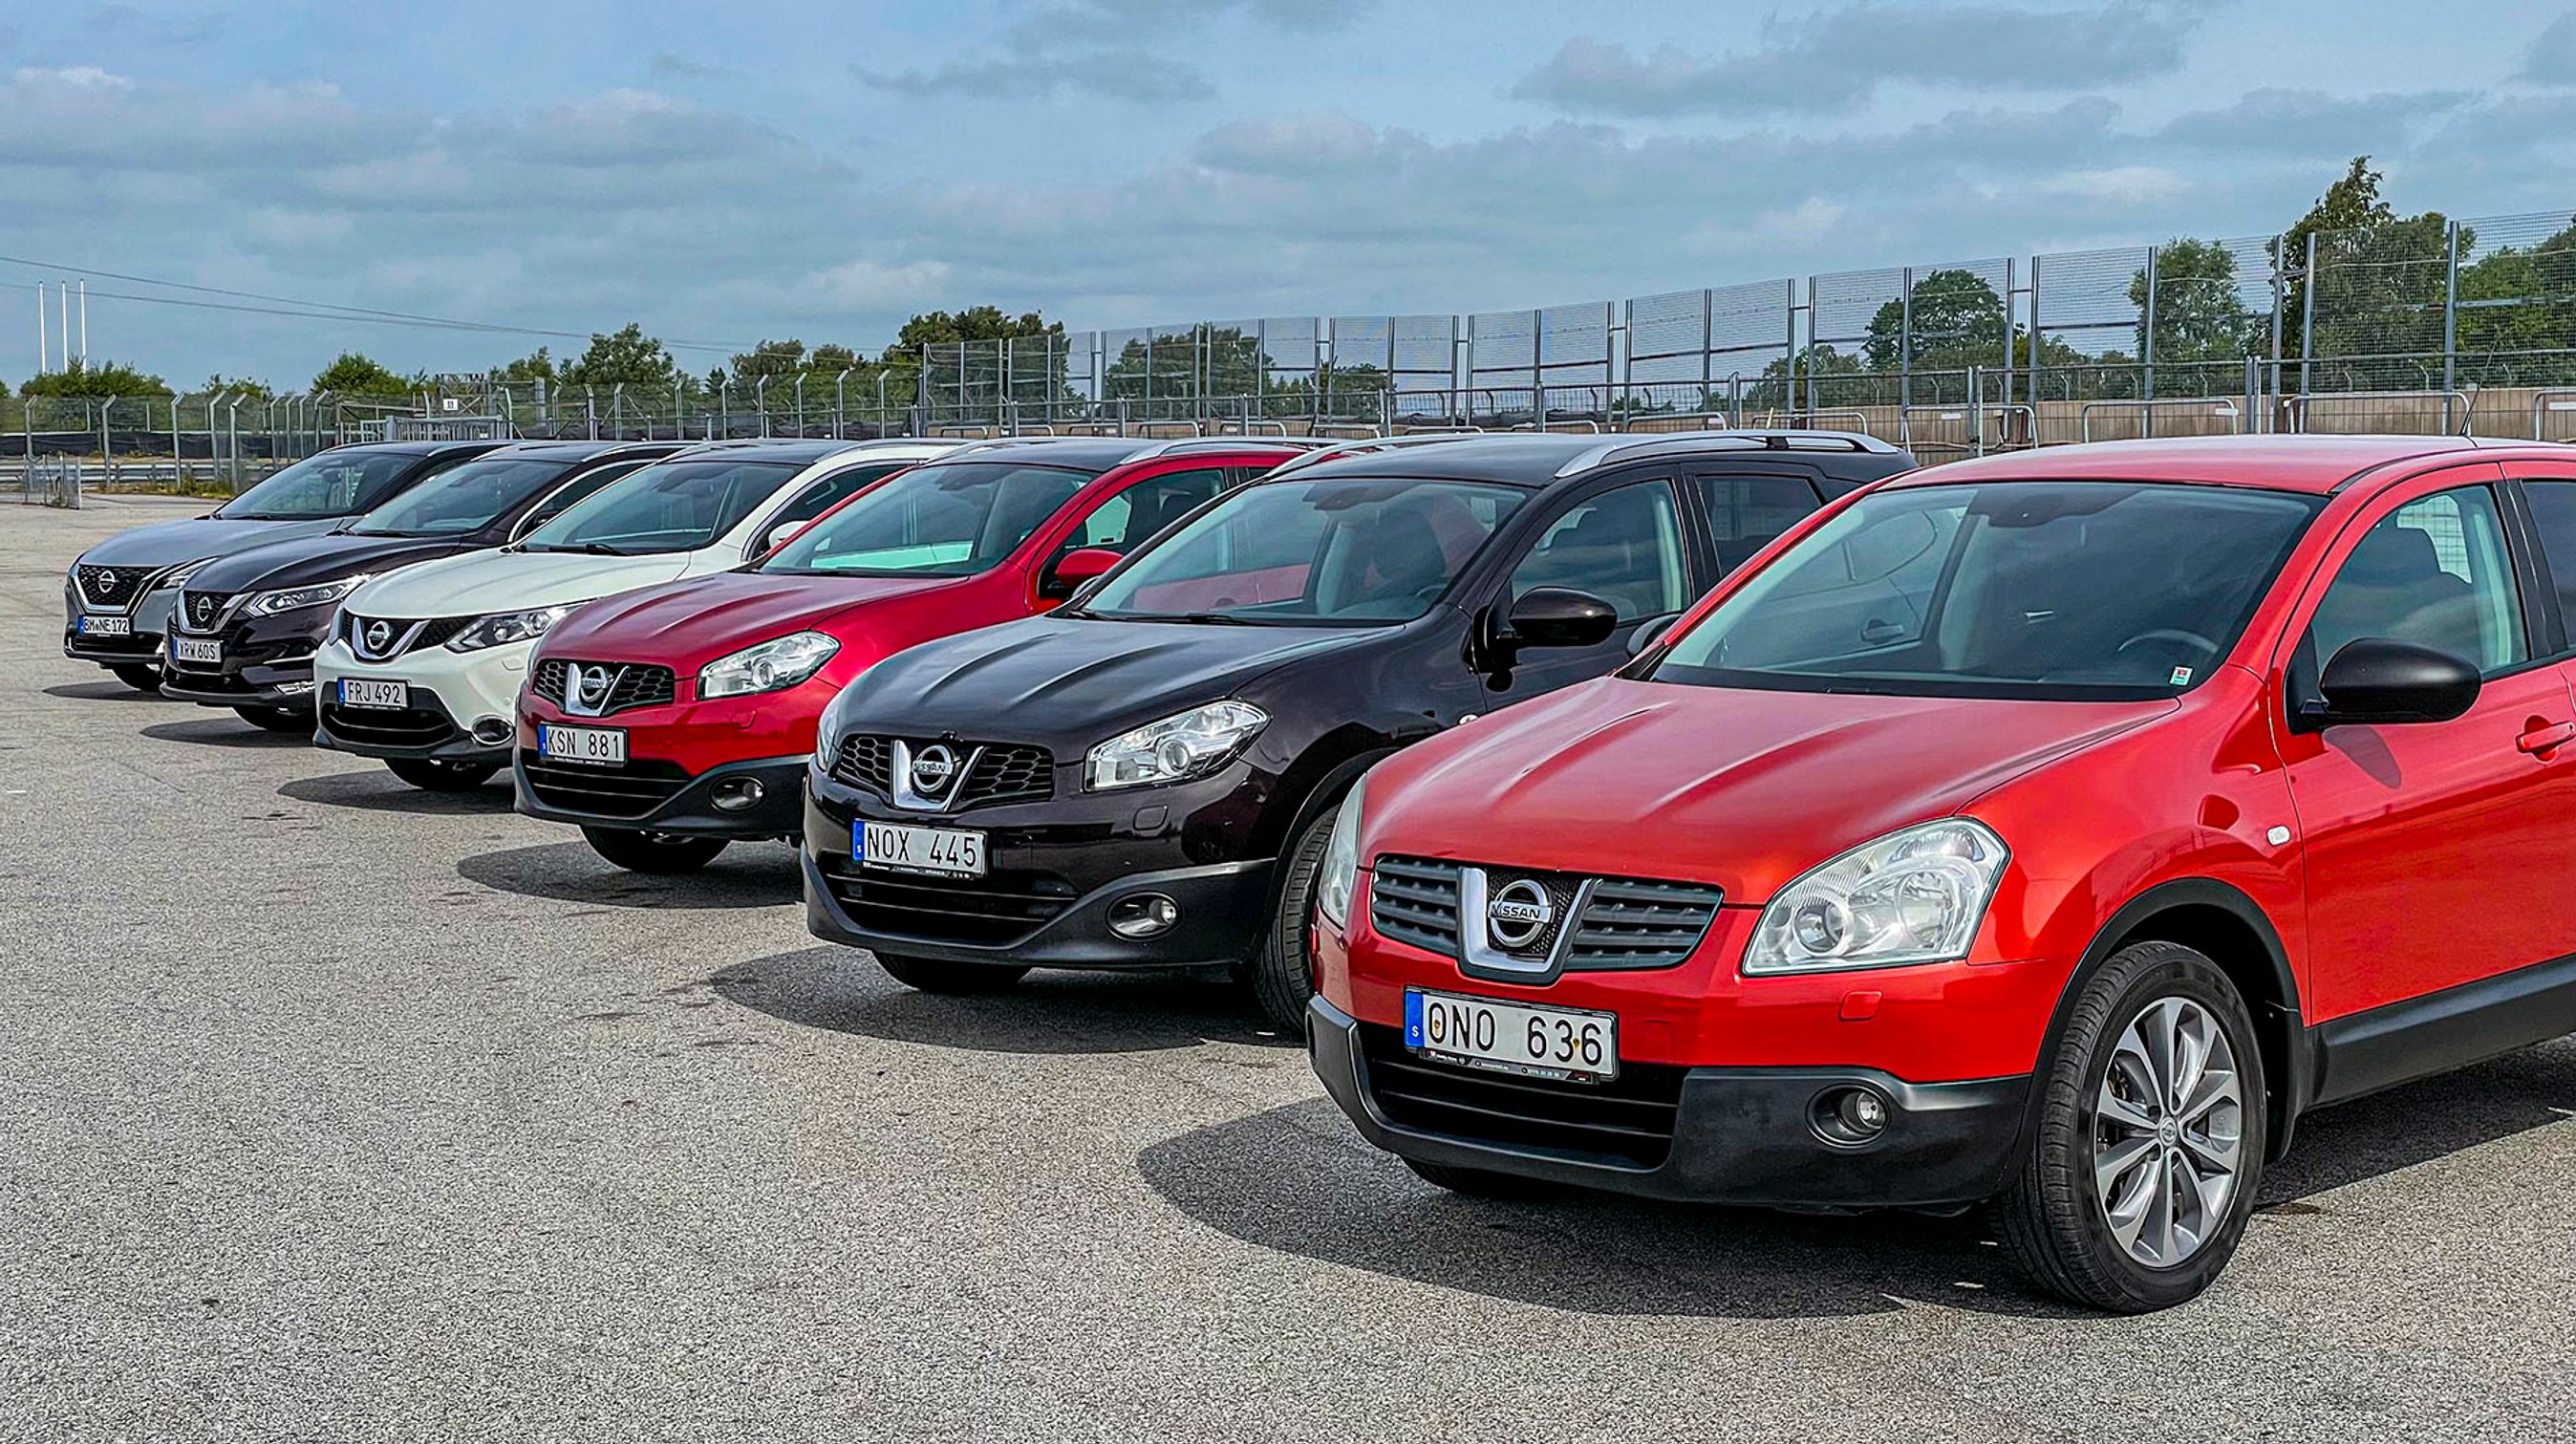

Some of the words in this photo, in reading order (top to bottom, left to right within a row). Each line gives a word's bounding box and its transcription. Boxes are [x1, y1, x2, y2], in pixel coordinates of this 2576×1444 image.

[111, 619, 128, 633] 172
[348, 682, 371, 701] FRJ
[375, 684, 400, 703] 492
[547, 729, 576, 755] KSN
[588, 733, 619, 759] 881
[867, 827, 910, 861] NOX
[930, 833, 977, 868] 445
[1490, 901, 1541, 919] NISSAN
[1411, 1025, 1419, 1038] S
[1428, 1002, 1496, 1052] ONO
[1528, 1016, 1602, 1067] 636
